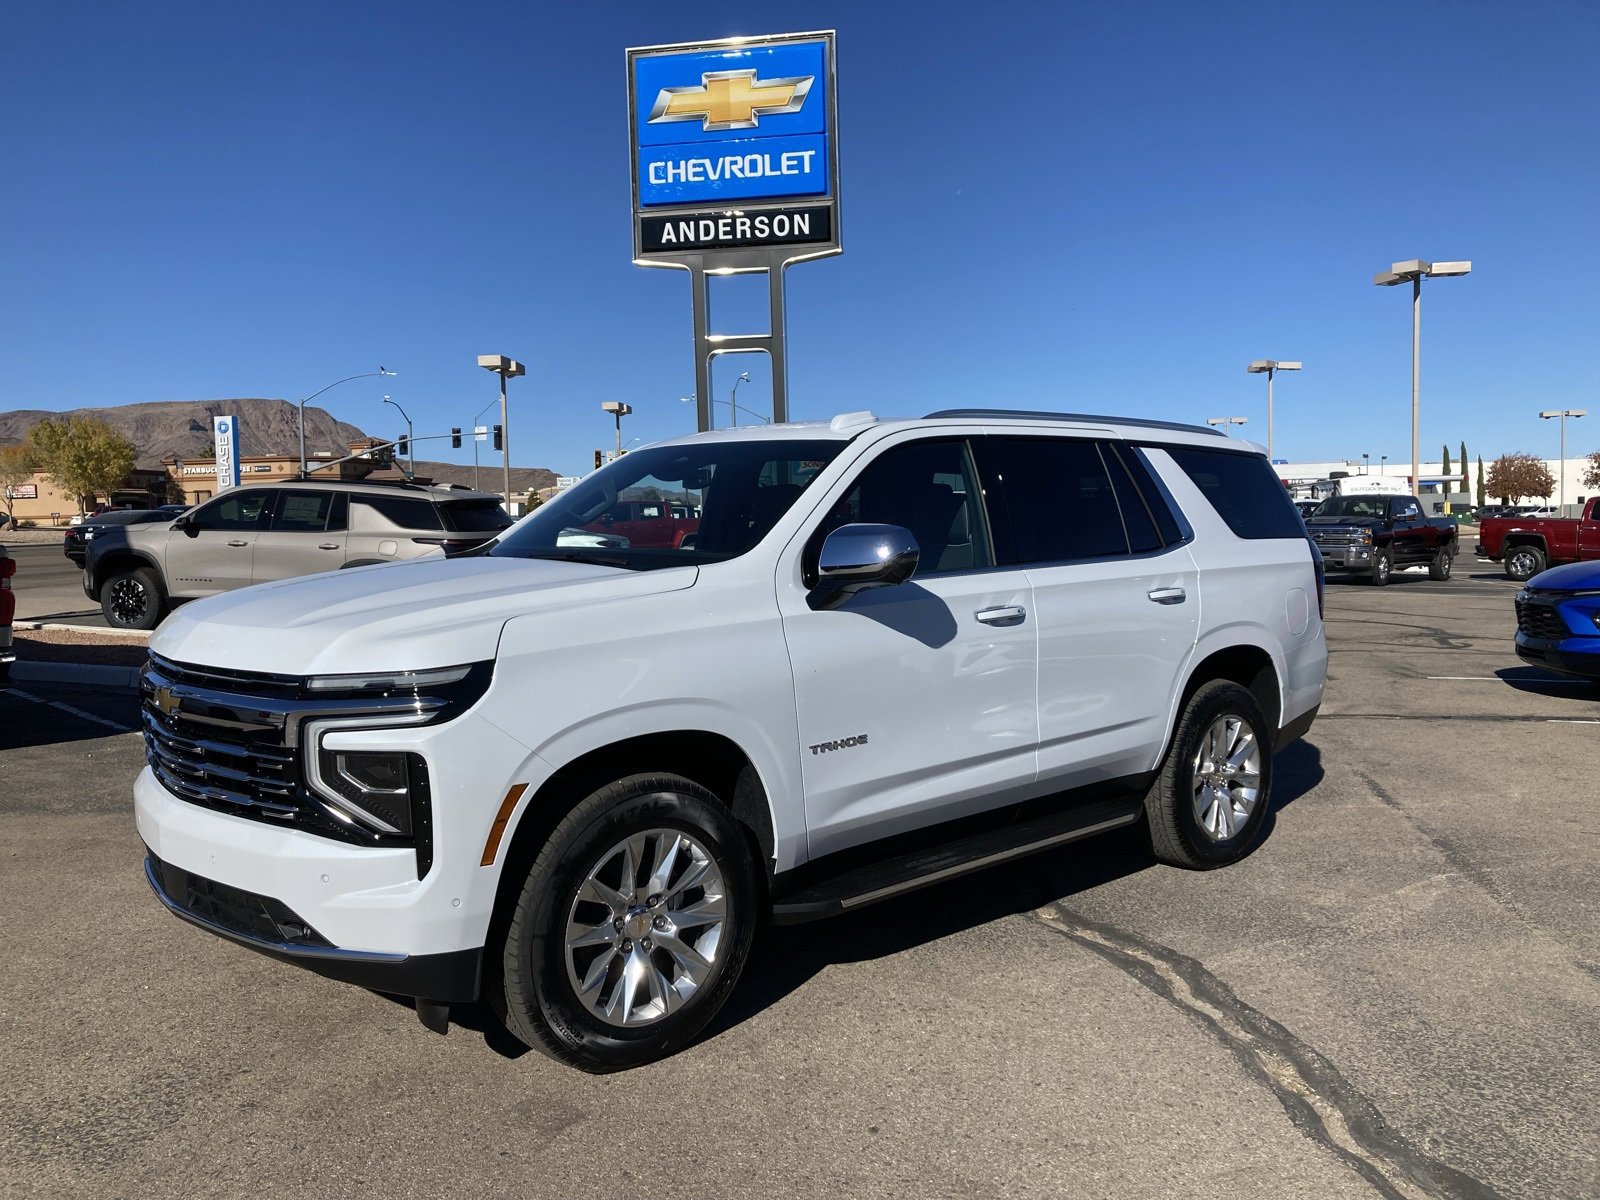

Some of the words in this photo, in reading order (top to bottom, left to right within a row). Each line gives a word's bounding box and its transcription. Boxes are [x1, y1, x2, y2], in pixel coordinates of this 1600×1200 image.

[648, 150, 816, 185] CHEVROLET
[661, 213, 810, 244] ANDERSON
[183, 466, 217, 475] STARBUC
[219, 436, 231, 487] CHASE
[808, 734, 869, 755] TAHOE
